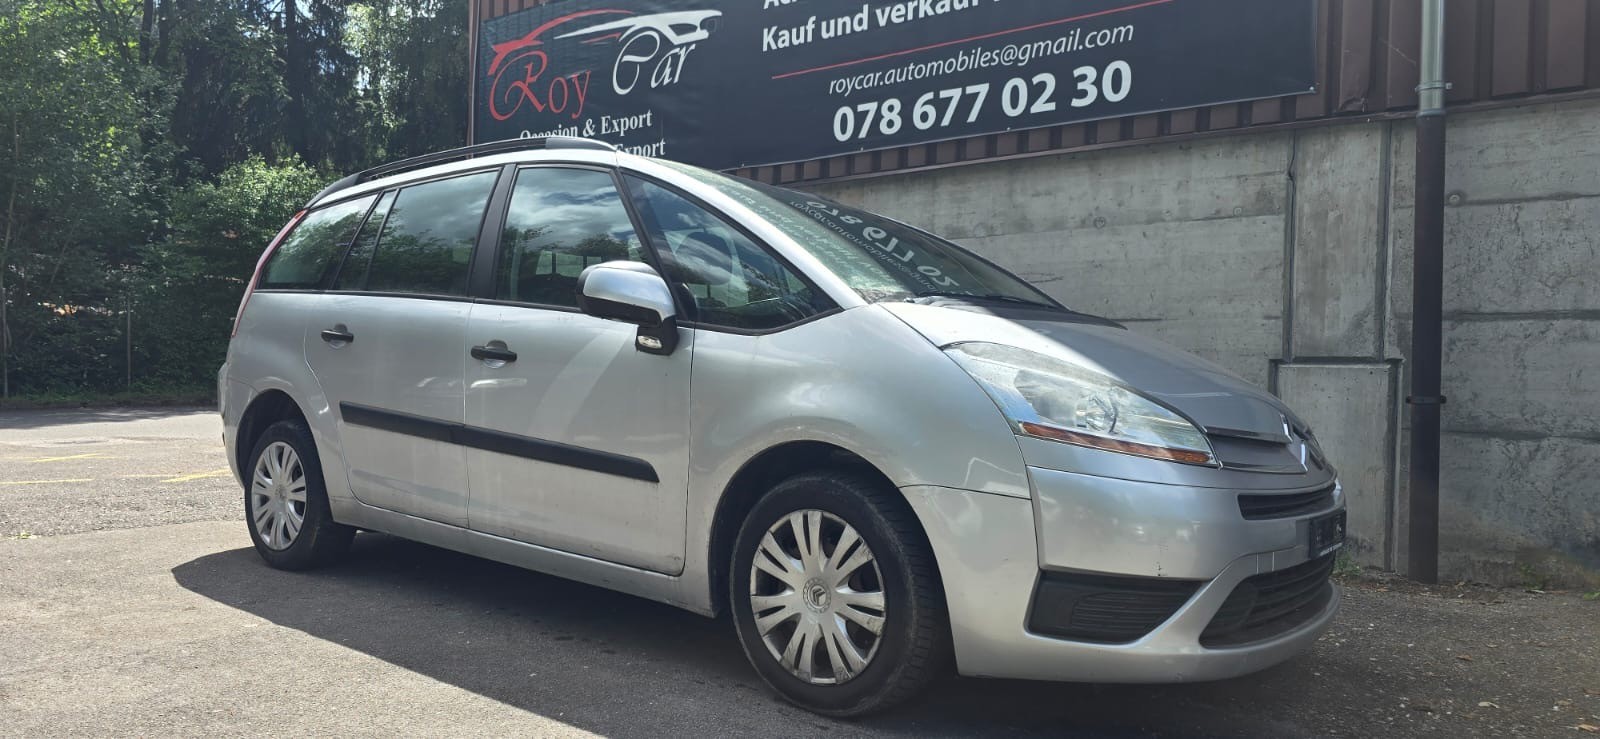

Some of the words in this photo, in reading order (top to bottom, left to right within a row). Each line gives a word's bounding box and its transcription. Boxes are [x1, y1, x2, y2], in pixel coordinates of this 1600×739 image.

[762, 15, 817, 52] Kauf
[820, 4, 869, 40] und
[875, 0, 979, 27] verkau
[828, 24, 1135, 97] roycar.automobiles@gmail.com
[488, 49, 592, 121] Roy
[612, 30, 697, 95] Car
[832, 98, 902, 142] 078
[912, 82, 990, 130] 677
[1001, 72, 1056, 117] 02
[1070, 60, 1132, 108] 30
[519, 123, 578, 138] Osion
[582, 118, 596, 138] &
[600, 109, 653, 137] Export
